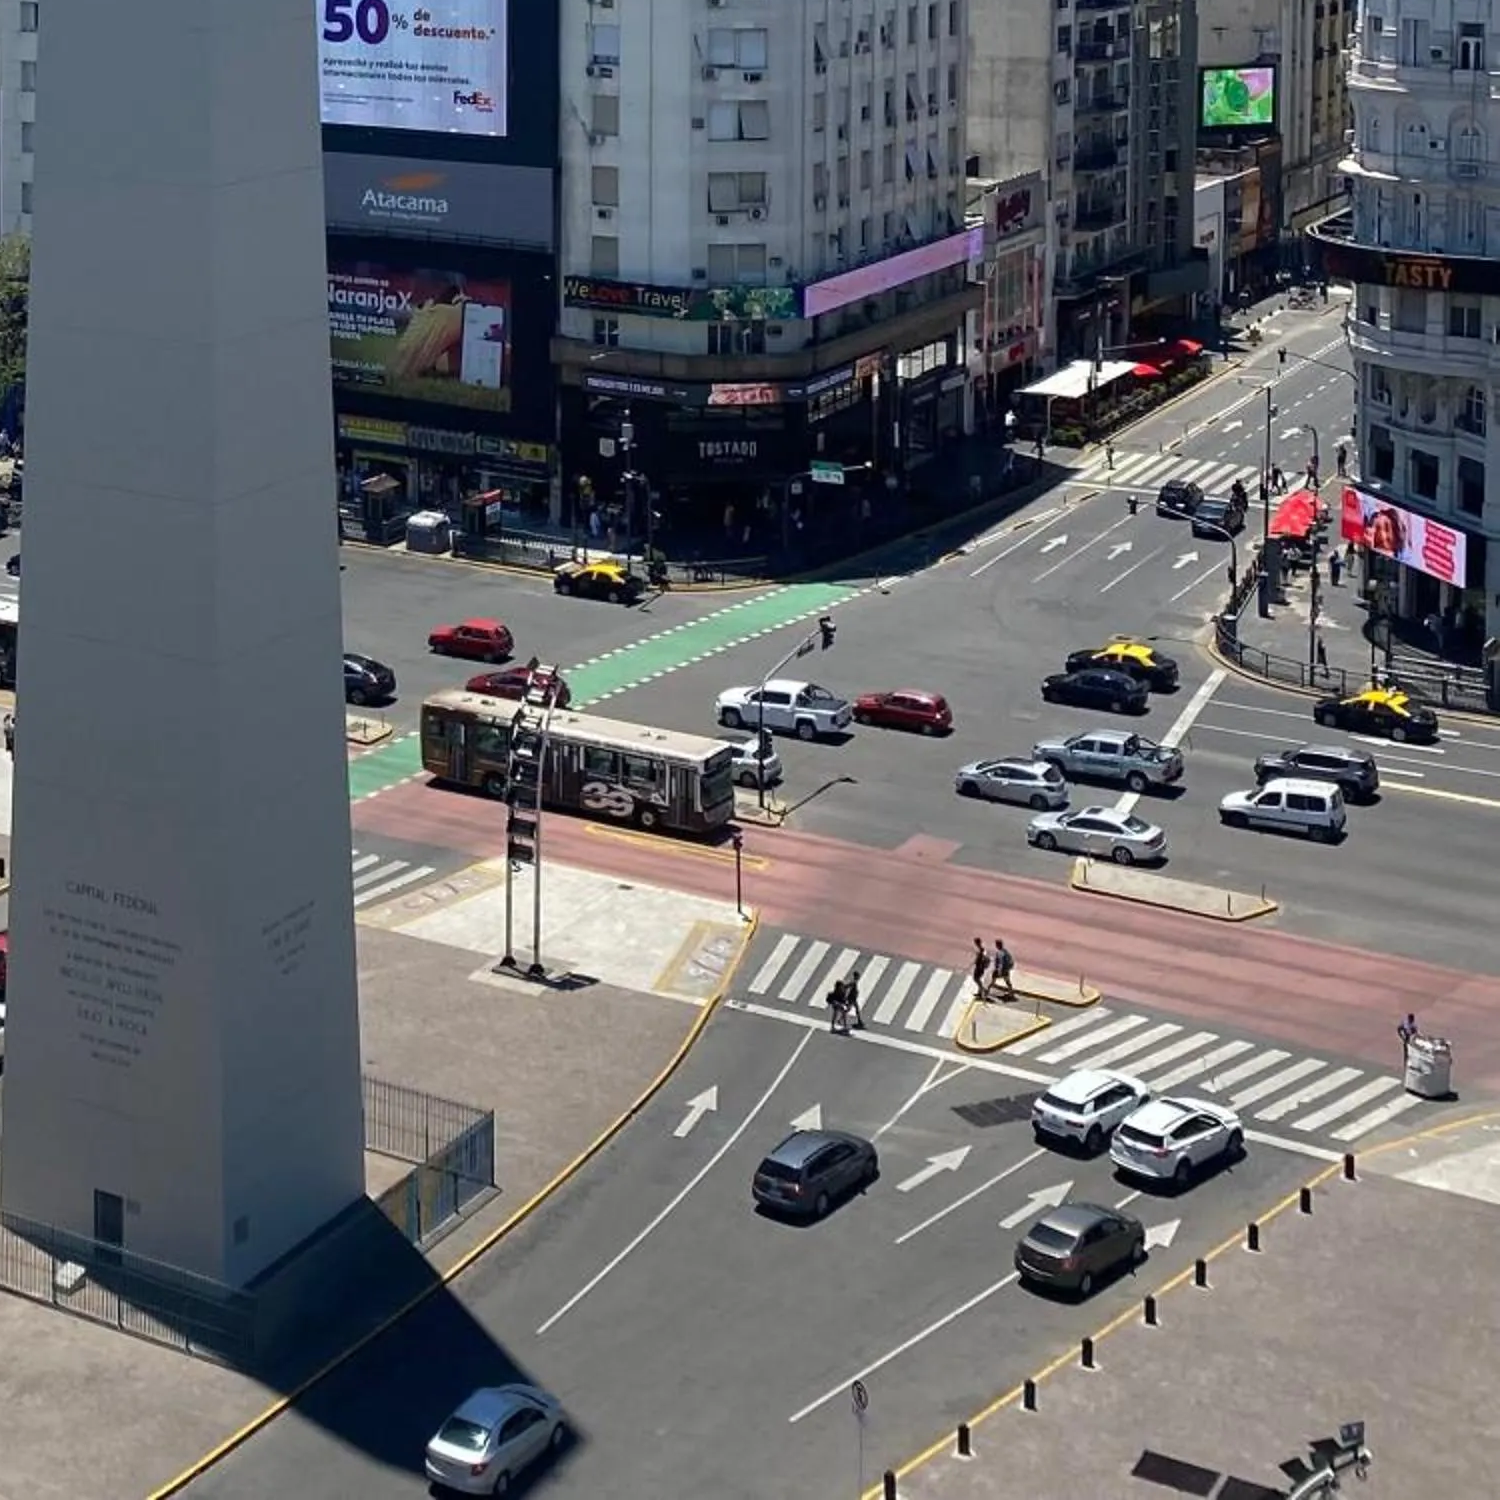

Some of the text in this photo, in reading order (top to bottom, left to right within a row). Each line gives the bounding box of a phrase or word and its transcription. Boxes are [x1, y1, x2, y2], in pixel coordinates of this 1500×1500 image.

[413, 8, 431, 21] de
[361, 189, 449, 213] Atacama
[1384, 262, 1452, 288] TASTY
[698, 441, 757, 459] TOSTADO
